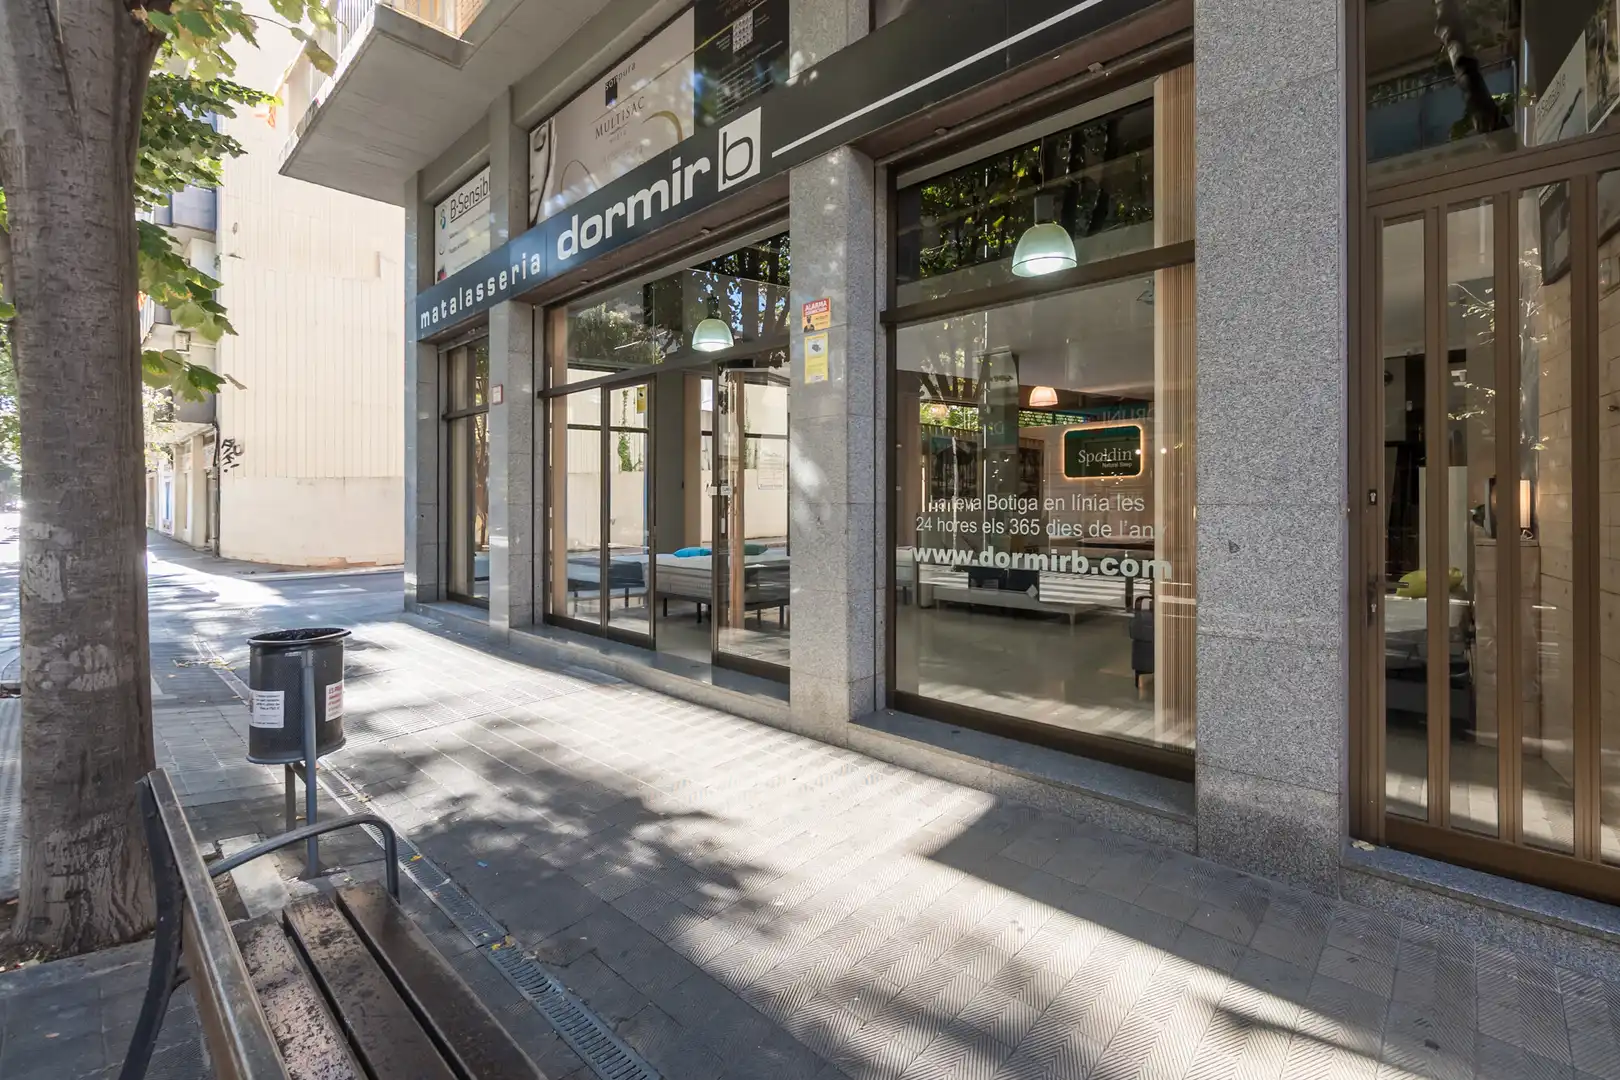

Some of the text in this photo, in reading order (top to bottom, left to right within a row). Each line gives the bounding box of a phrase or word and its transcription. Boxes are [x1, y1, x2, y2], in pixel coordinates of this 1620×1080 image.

[595, 96, 645, 139] MULTISAC
[420, 252, 541, 329] matalasseria
[557, 156, 711, 261] dormir
[987, 494, 1038, 515] Botiga
[1043, 497, 1065, 512] en
[1071, 493, 1110, 512] línia
[1116, 492, 1146, 513] les
[916, 516, 933, 532] 24
[937, 516, 978, 533] hores
[982, 518, 1005, 534] els
[1009, 518, 1040, 536] 365
[1046, 519, 1083, 537] dies
[1088, 520, 1112, 539] de
[912, 545, 1173, 581] www.dormirb.com
